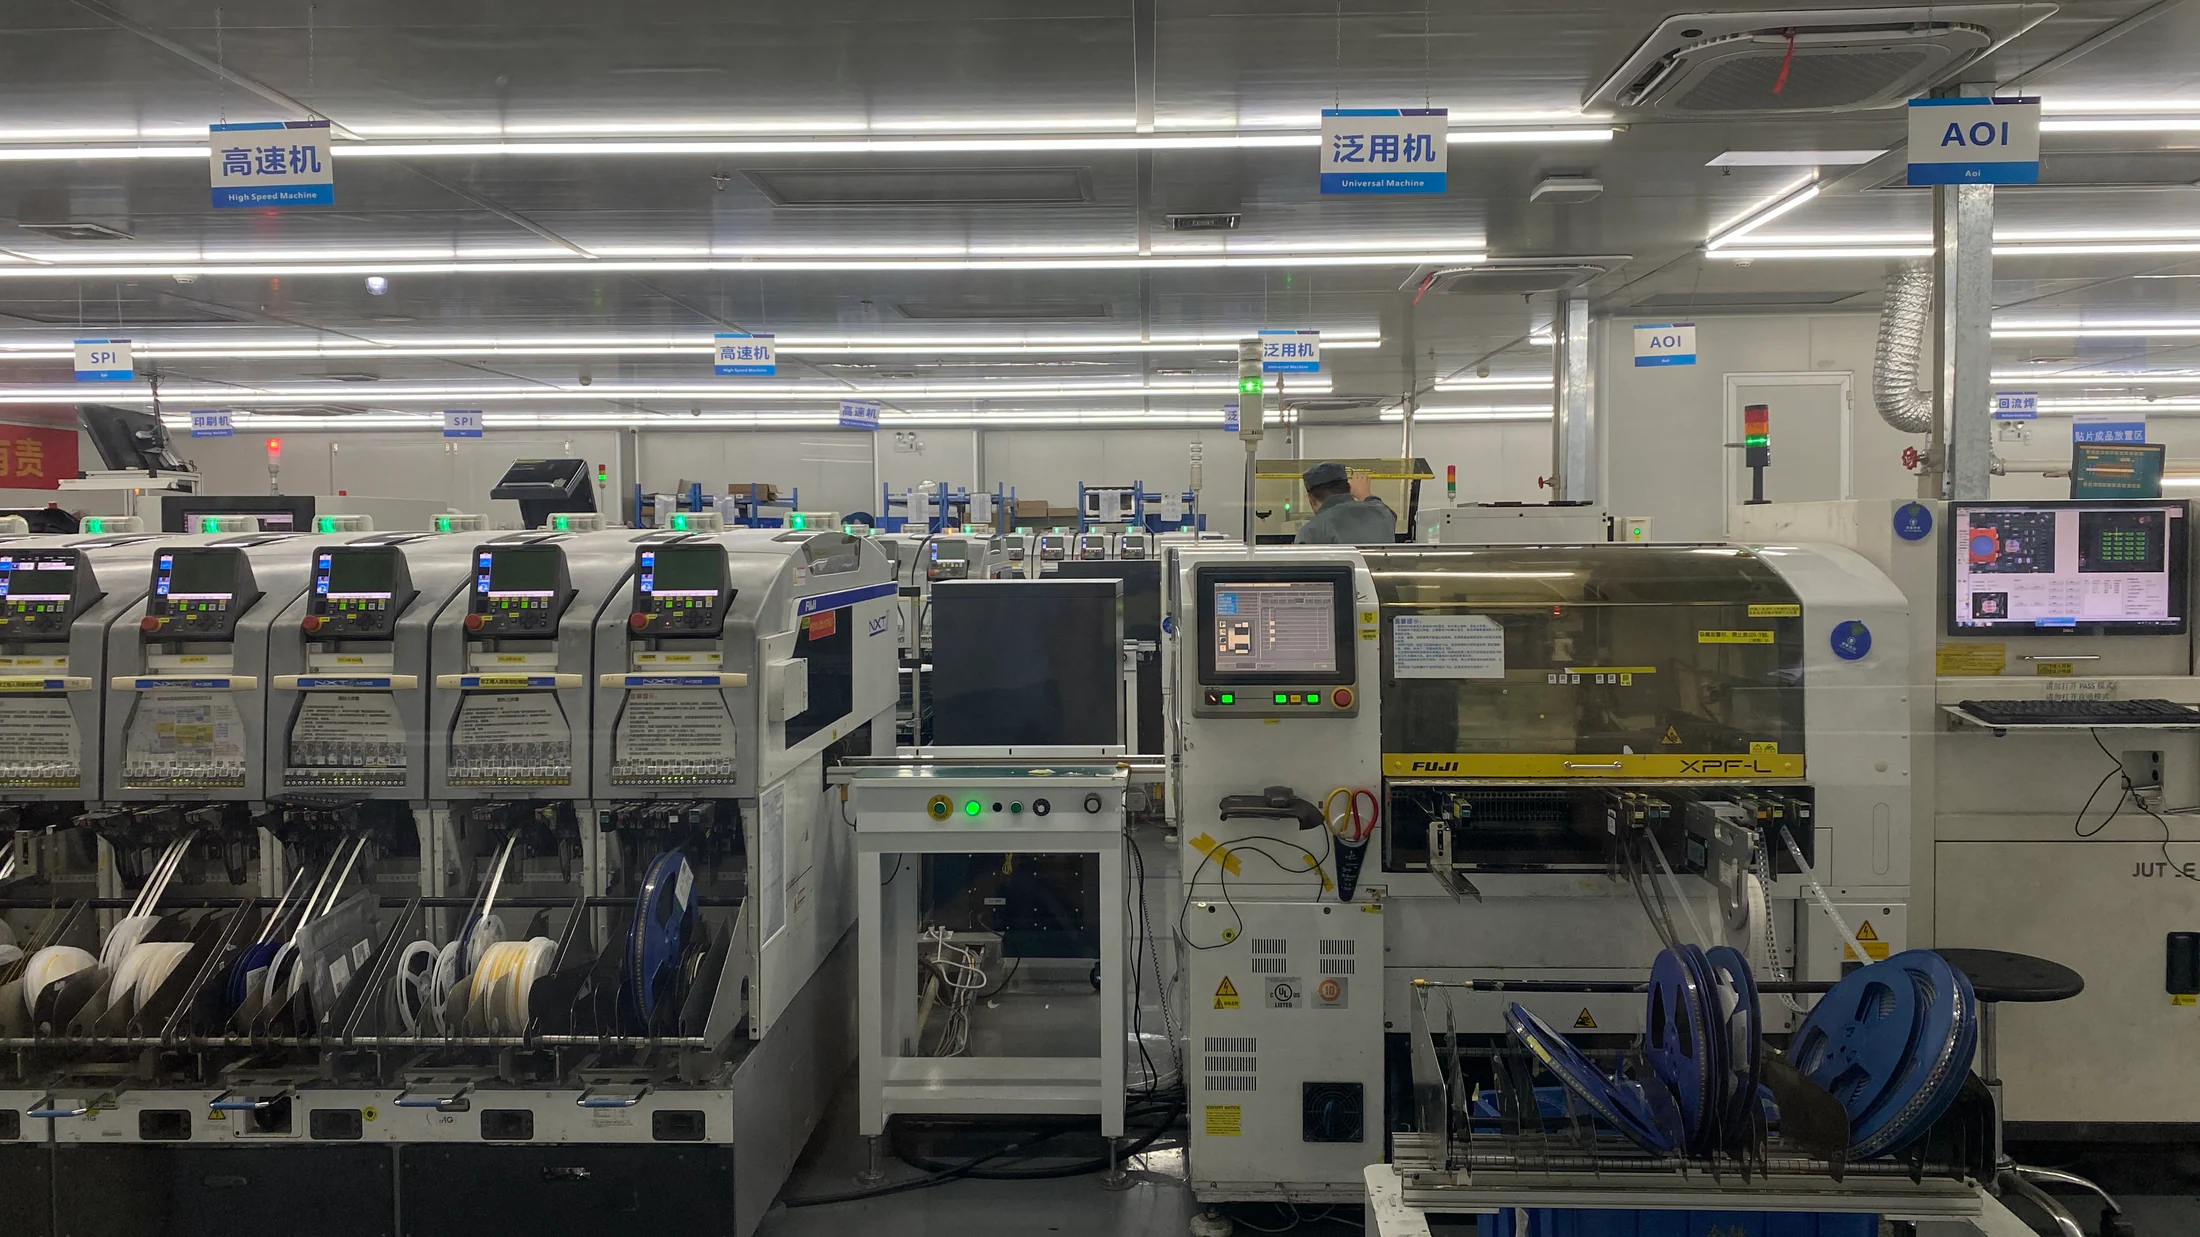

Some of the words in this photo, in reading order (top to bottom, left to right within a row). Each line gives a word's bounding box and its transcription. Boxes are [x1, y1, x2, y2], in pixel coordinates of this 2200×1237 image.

[1940, 121, 2009, 147] AOI
[1332, 133, 1436, 163] 泛用机
[220, 144, 321, 177] 高速机
[1964, 169, 1981, 177] Aoi
[1341, 179, 1384, 187] Universal
[1386, 179, 1425, 187] Machine
[228, 193, 249, 203] High
[251, 192, 278, 202] Speed
[279, 191, 317, 200] Machine
[1649, 335, 1681, 349] AOI
[720, 345, 770, 361] 高速机
[1263, 342, 1314, 358] 泛用机
[90, 352, 116, 364] SPI
[1999, 397, 2035, 409] 回流焊
[194, 415, 230, 427] 印刷机
[454, 417, 473, 426] SPI
[2074, 429, 2144, 442] 贴片成品放置区
[2079, 682, 2096, 690] PASS
[1411, 761, 1459, 772] FUJI
[1679, 759, 1773, 774] XPF-L
[2131, 862, 2196, 878] JUTE
